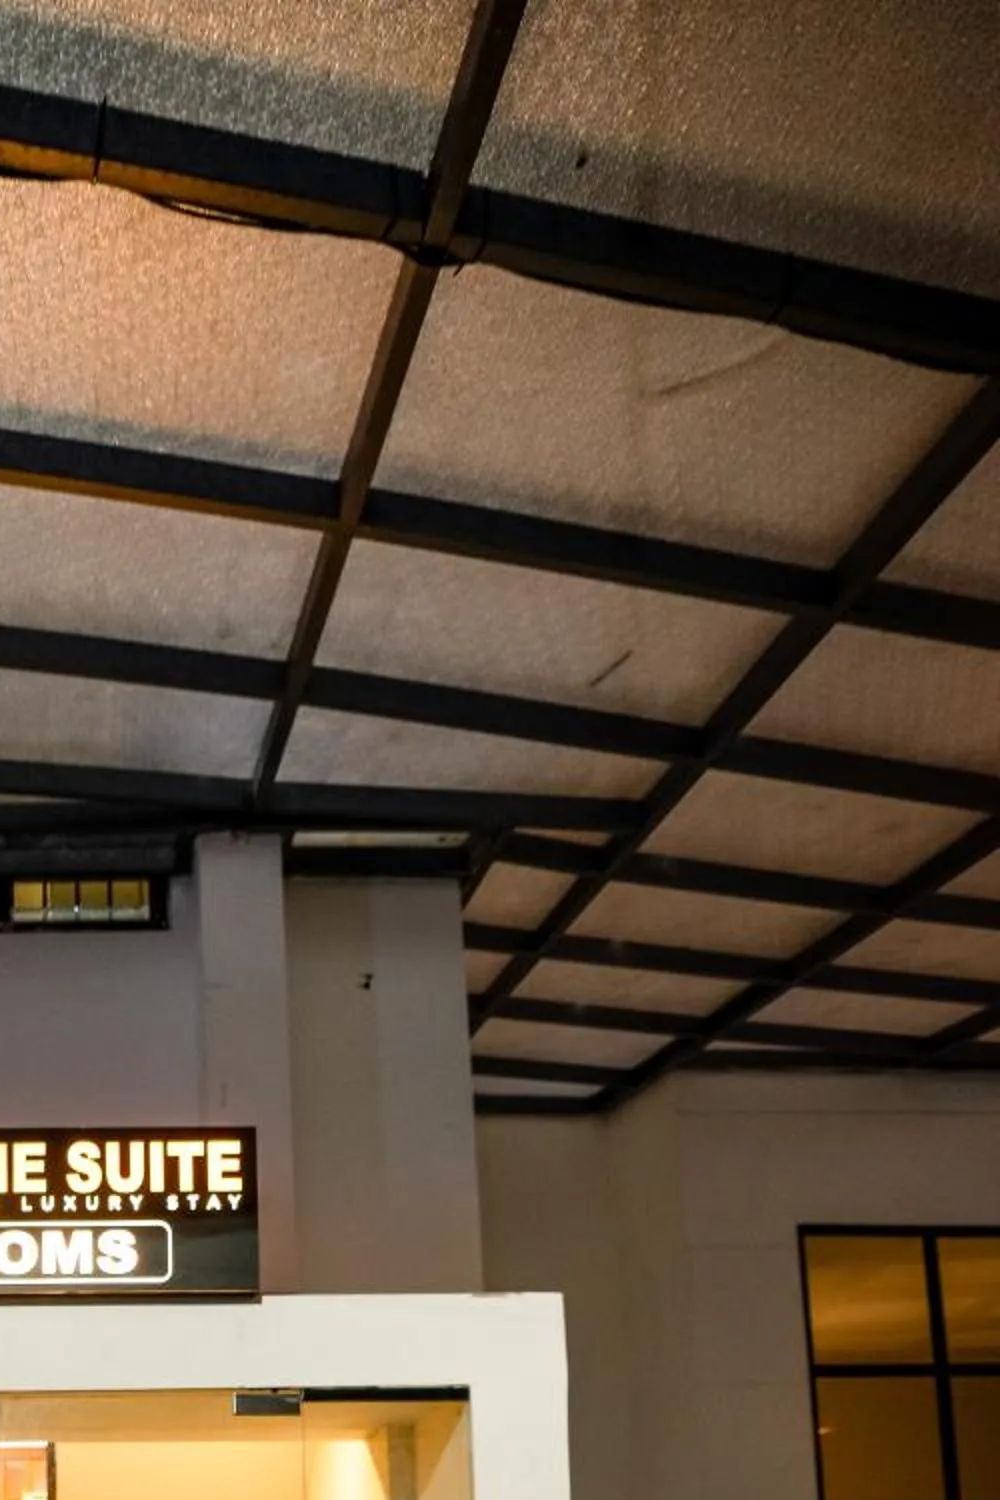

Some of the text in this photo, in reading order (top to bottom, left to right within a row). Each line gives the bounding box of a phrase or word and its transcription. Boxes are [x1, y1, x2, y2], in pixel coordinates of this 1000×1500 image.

[66, 1140, 243, 1194] SUITE
[21, 1194, 143, 1212] LUXURY
[166, 1193, 242, 1211] STAY
